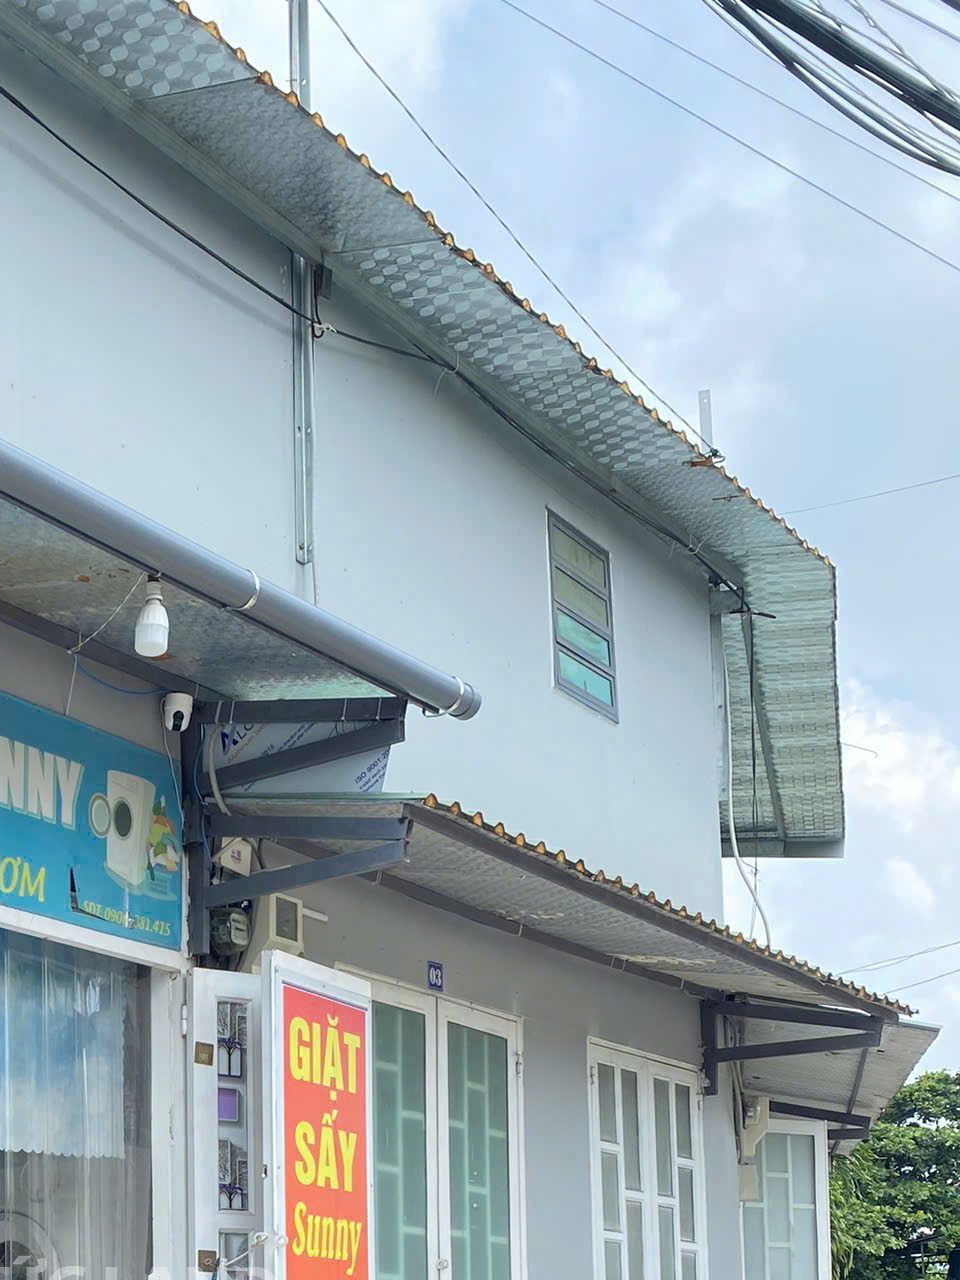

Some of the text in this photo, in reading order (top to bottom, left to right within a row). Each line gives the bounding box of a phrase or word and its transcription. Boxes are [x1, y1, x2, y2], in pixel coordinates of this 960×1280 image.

[429, 967, 442, 986] 03
[289, 1013, 361, 1101] GIẶT
[294, 1109, 358, 1192] SẤY
[292, 1201, 362, 1276] Sunny
